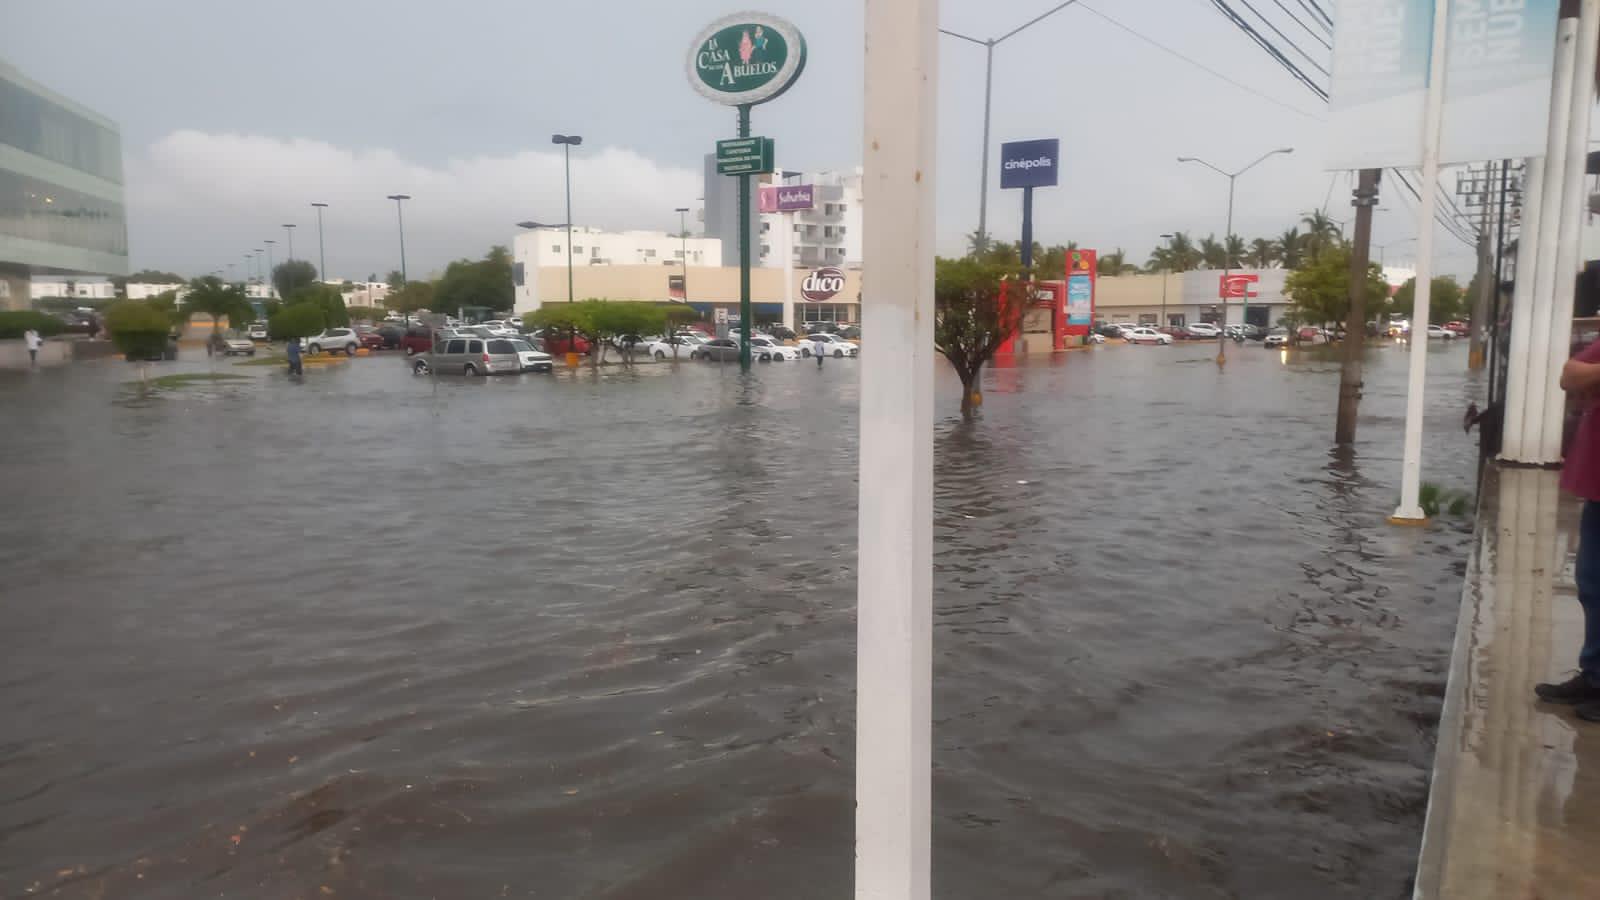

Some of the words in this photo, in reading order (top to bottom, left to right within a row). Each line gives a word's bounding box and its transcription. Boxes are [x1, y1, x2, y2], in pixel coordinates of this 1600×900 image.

[707, 38, 719, 50] LA
[698, 49, 731, 69] CASA
[720, 61, 777, 85] ABUELOS
[802, 271, 844, 292] dico
